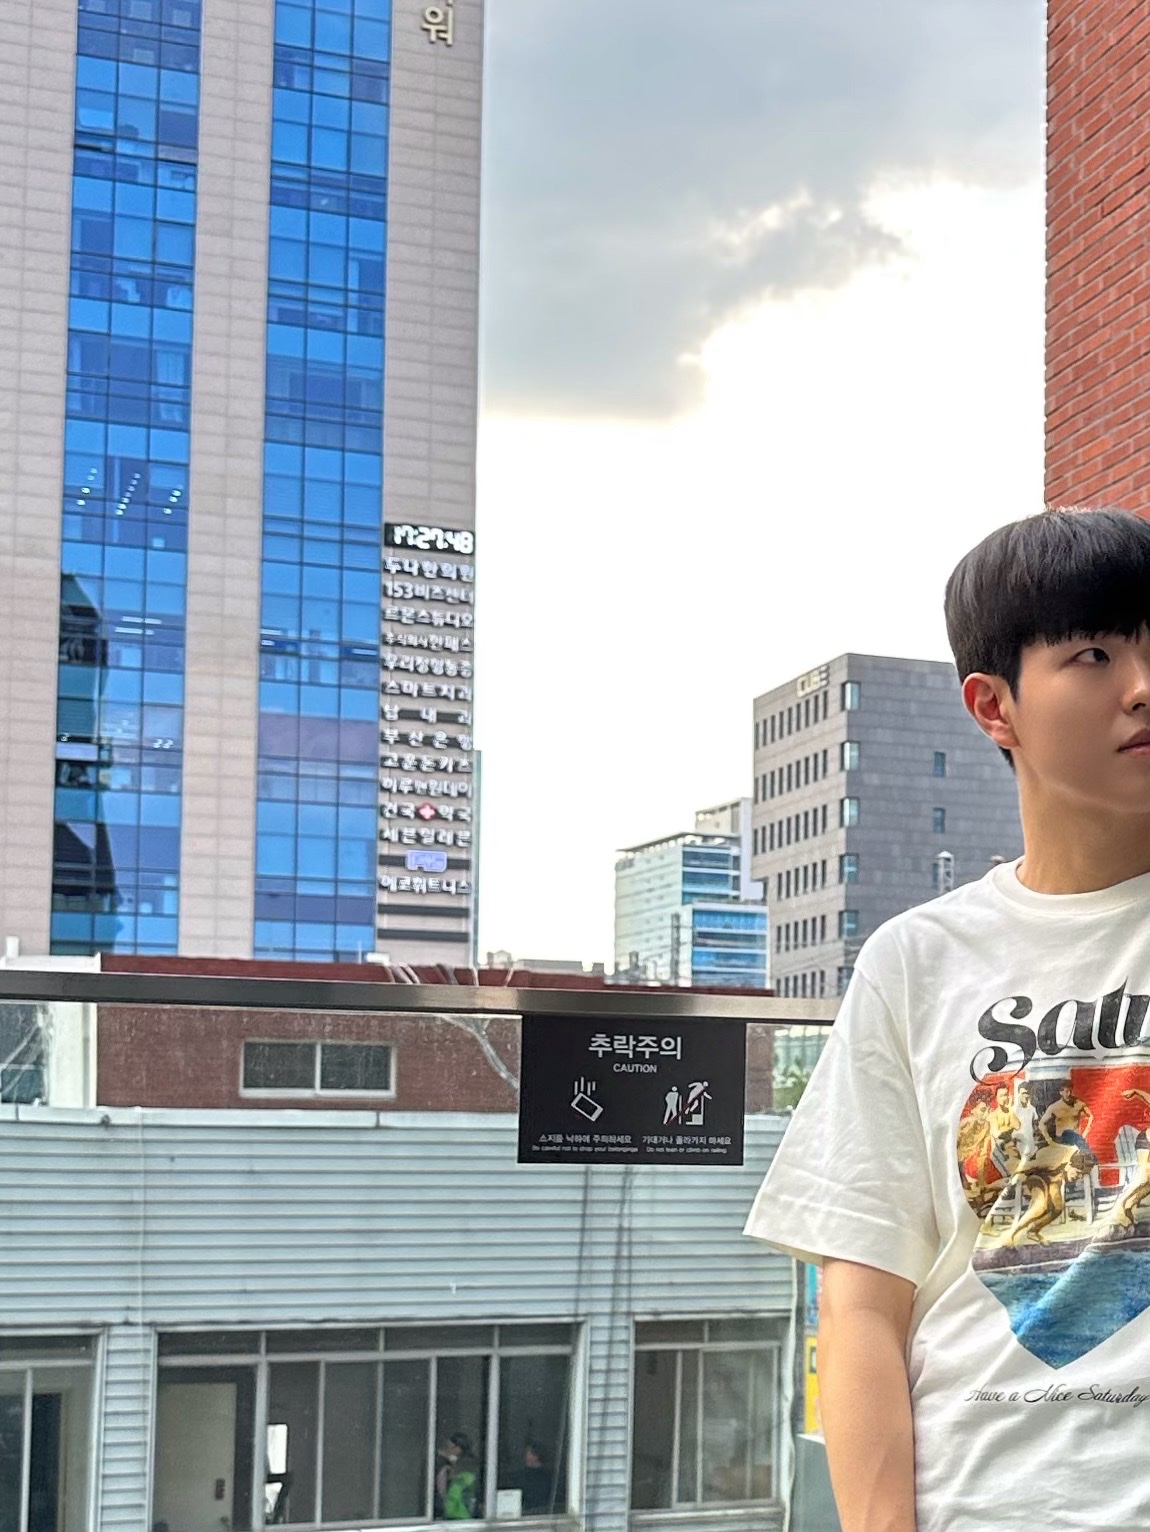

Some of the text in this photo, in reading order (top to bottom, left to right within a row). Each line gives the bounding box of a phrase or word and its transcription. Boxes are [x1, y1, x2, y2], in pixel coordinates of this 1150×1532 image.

[382, 828, 473, 848] 세븐일레븐
[588, 1033, 682, 1060] 추락주의
[613, 1063, 658, 1073] CAUTION
[965, 1382, 1006, 1402] Have
[1008, 1391, 1021, 1402] a
[1024, 1384, 1073, 1403] Nice
